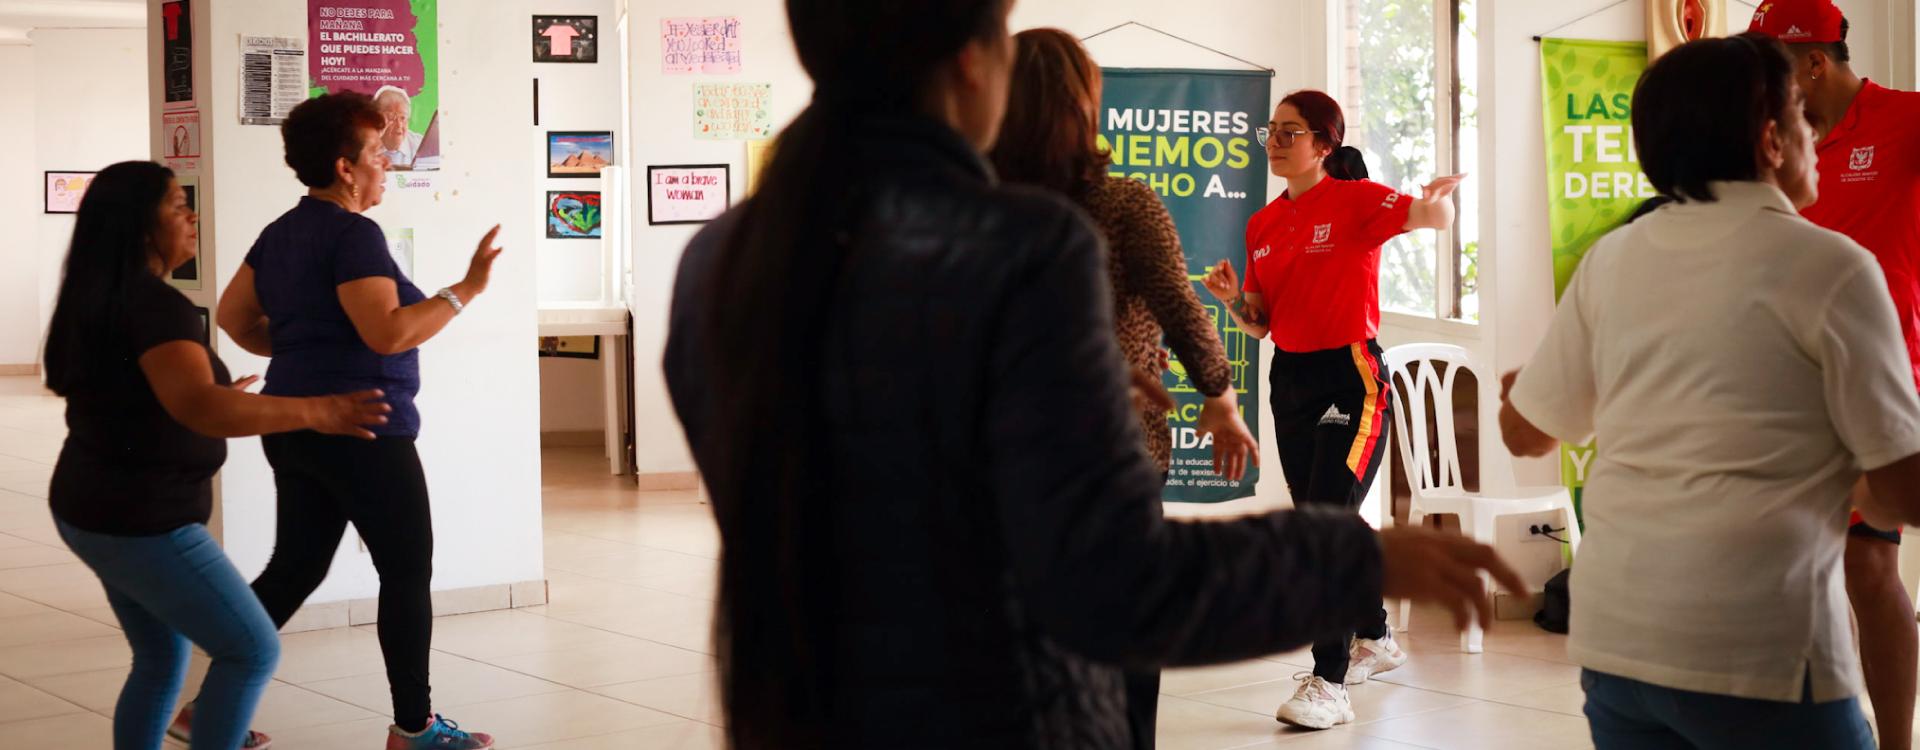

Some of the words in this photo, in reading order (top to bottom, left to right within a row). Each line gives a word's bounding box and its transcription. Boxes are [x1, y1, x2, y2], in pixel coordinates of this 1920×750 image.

[320, 7, 336, 17] NO
[337, 8, 366, 18] DEJES
[368, 9, 394, 19] PARA
[320, 18, 363, 30] MAÑANA
[320, 32, 331, 41] EL
[333, 33, 404, 42] BACHILLERATO
[321, 45, 341, 54] QUE
[343, 45, 380, 54] PUEDES
[382, 46, 413, 54] HACER
[321, 57, 345, 66] HOY!
[1567, 93, 1631, 120] LAS
[1107, 108, 1249, 134] MUJERES
[656, 173, 663, 184] I
[665, 175, 679, 184] am
[682, 175, 689, 184] a
[691, 171, 718, 185] brave
[1568, 449, 1594, 481] Y
[1197, 479, 1228, 488] ejercicio
